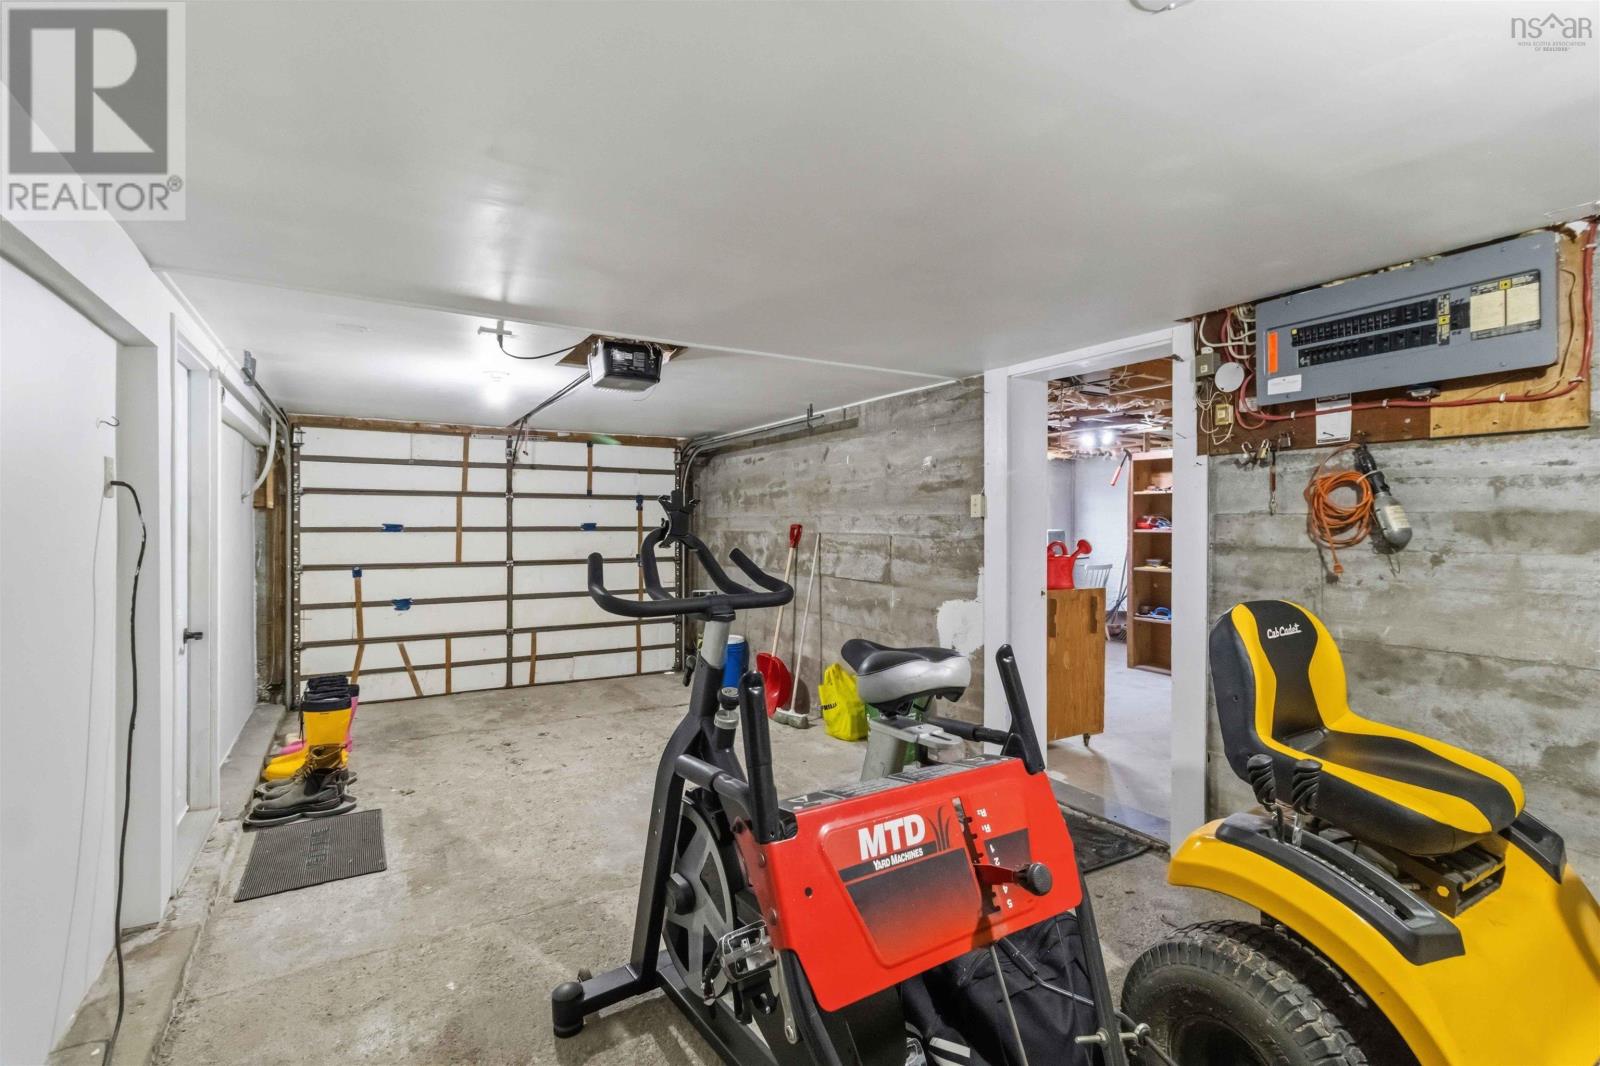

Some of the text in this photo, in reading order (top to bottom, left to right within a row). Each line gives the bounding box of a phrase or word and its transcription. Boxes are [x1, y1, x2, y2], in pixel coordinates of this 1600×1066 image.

[858, 814, 926, 861] MTD
[989, 843, 996, 854] 1
[890, 847, 924, 866] MACHINES
[993, 856, 1001, 866] 2
[1002, 884, 1009, 895] 4
[1006, 898, 1014, 909] 5
